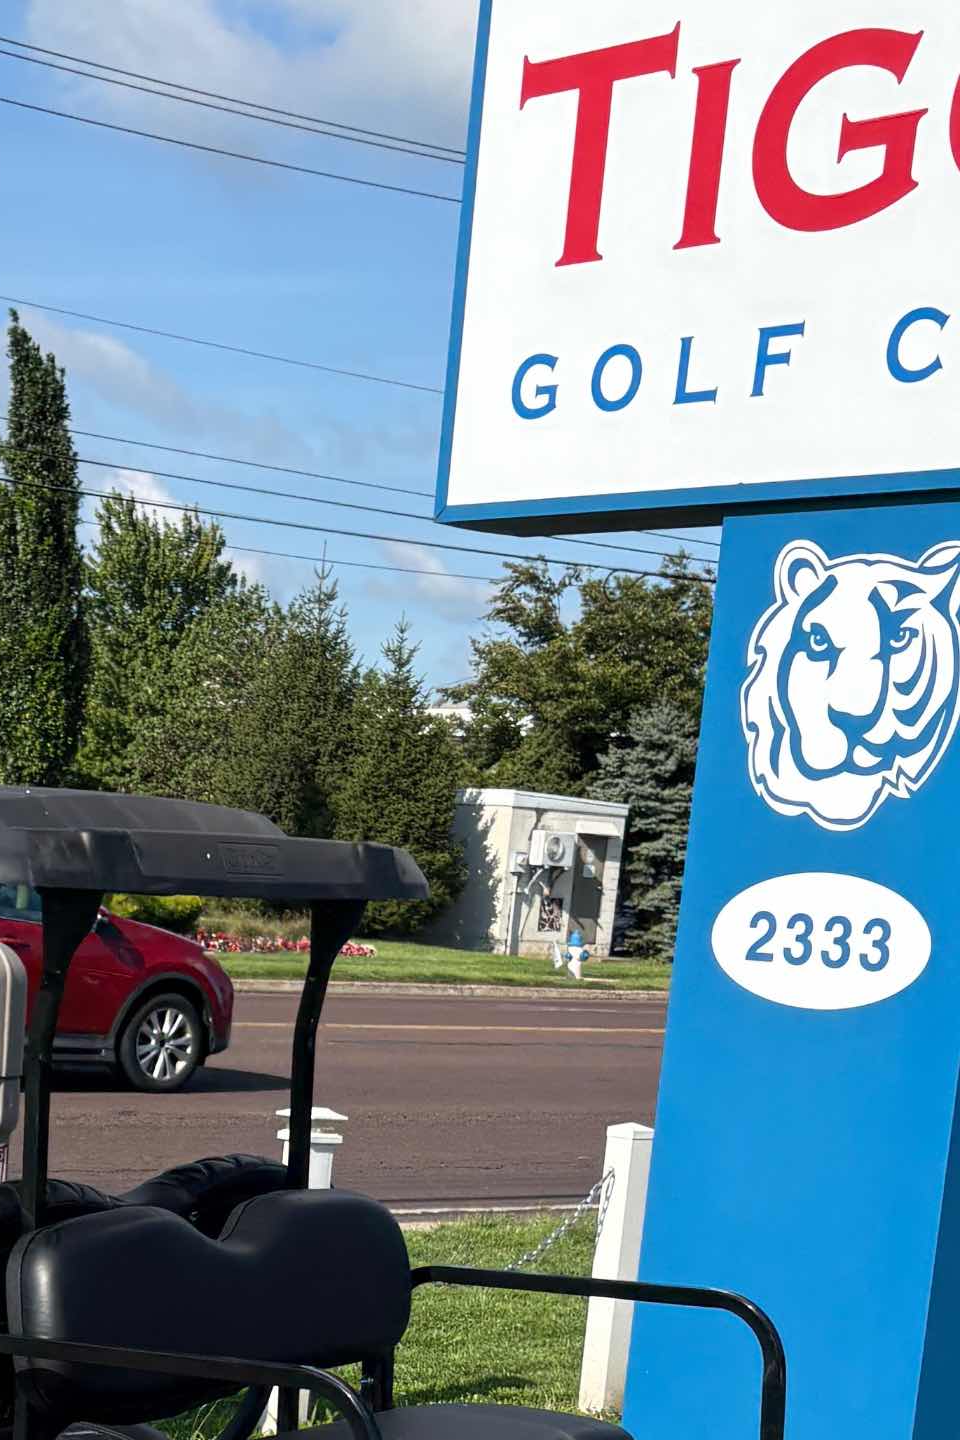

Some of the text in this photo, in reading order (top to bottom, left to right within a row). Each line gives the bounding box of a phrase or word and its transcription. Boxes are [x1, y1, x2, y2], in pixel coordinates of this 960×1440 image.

[520, 20, 960, 267] TIG
[511, 320, 805, 420] GOLF
[745, 910, 892, 972] 2333
